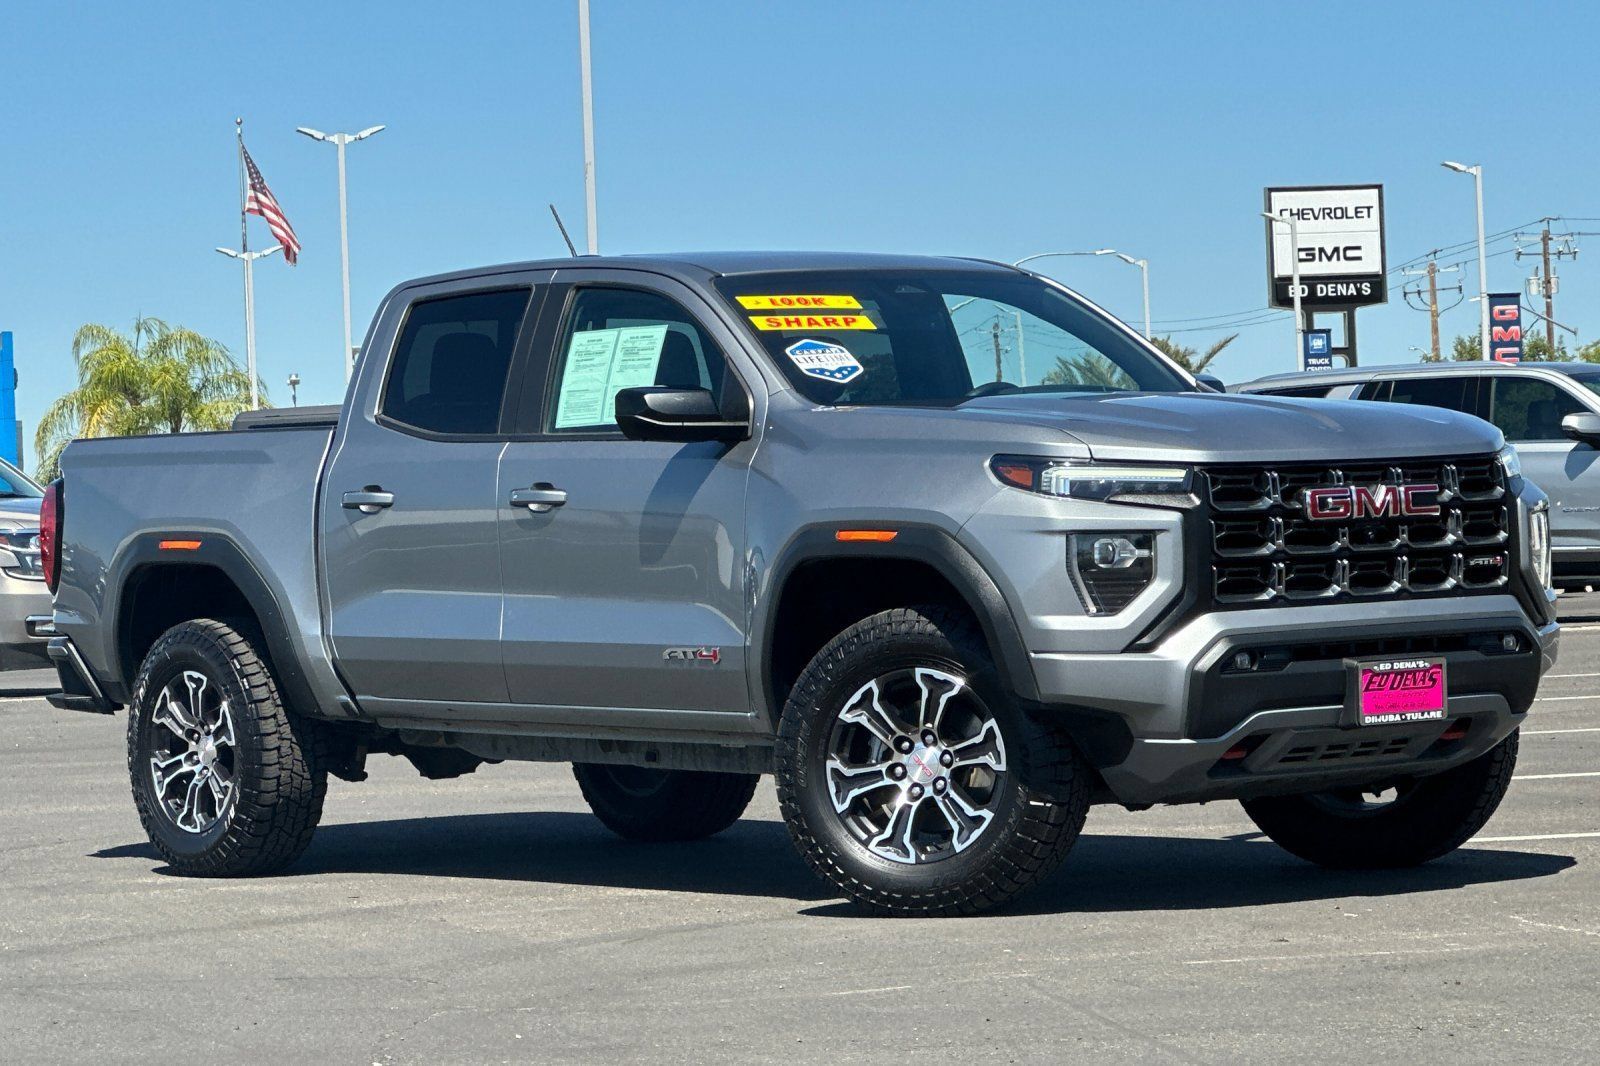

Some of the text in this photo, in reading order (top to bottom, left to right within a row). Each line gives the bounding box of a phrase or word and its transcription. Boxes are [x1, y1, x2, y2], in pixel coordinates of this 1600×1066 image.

[1280, 206, 1374, 221] CHEVROLET
[1297, 246, 1363, 263] GMC
[1288, 282, 1372, 298] ED DENA'S
[768, 297, 830, 307] LOOK
[766, 316, 858, 328] SHARP
[1492, 305, 1521, 363] GMC
[1305, 484, 1441, 521] GMC
[662, 647, 720, 665] AT4
[1393, 661, 1425, 669] DENA'S
[1405, 710, 1443, 720] TULARE
